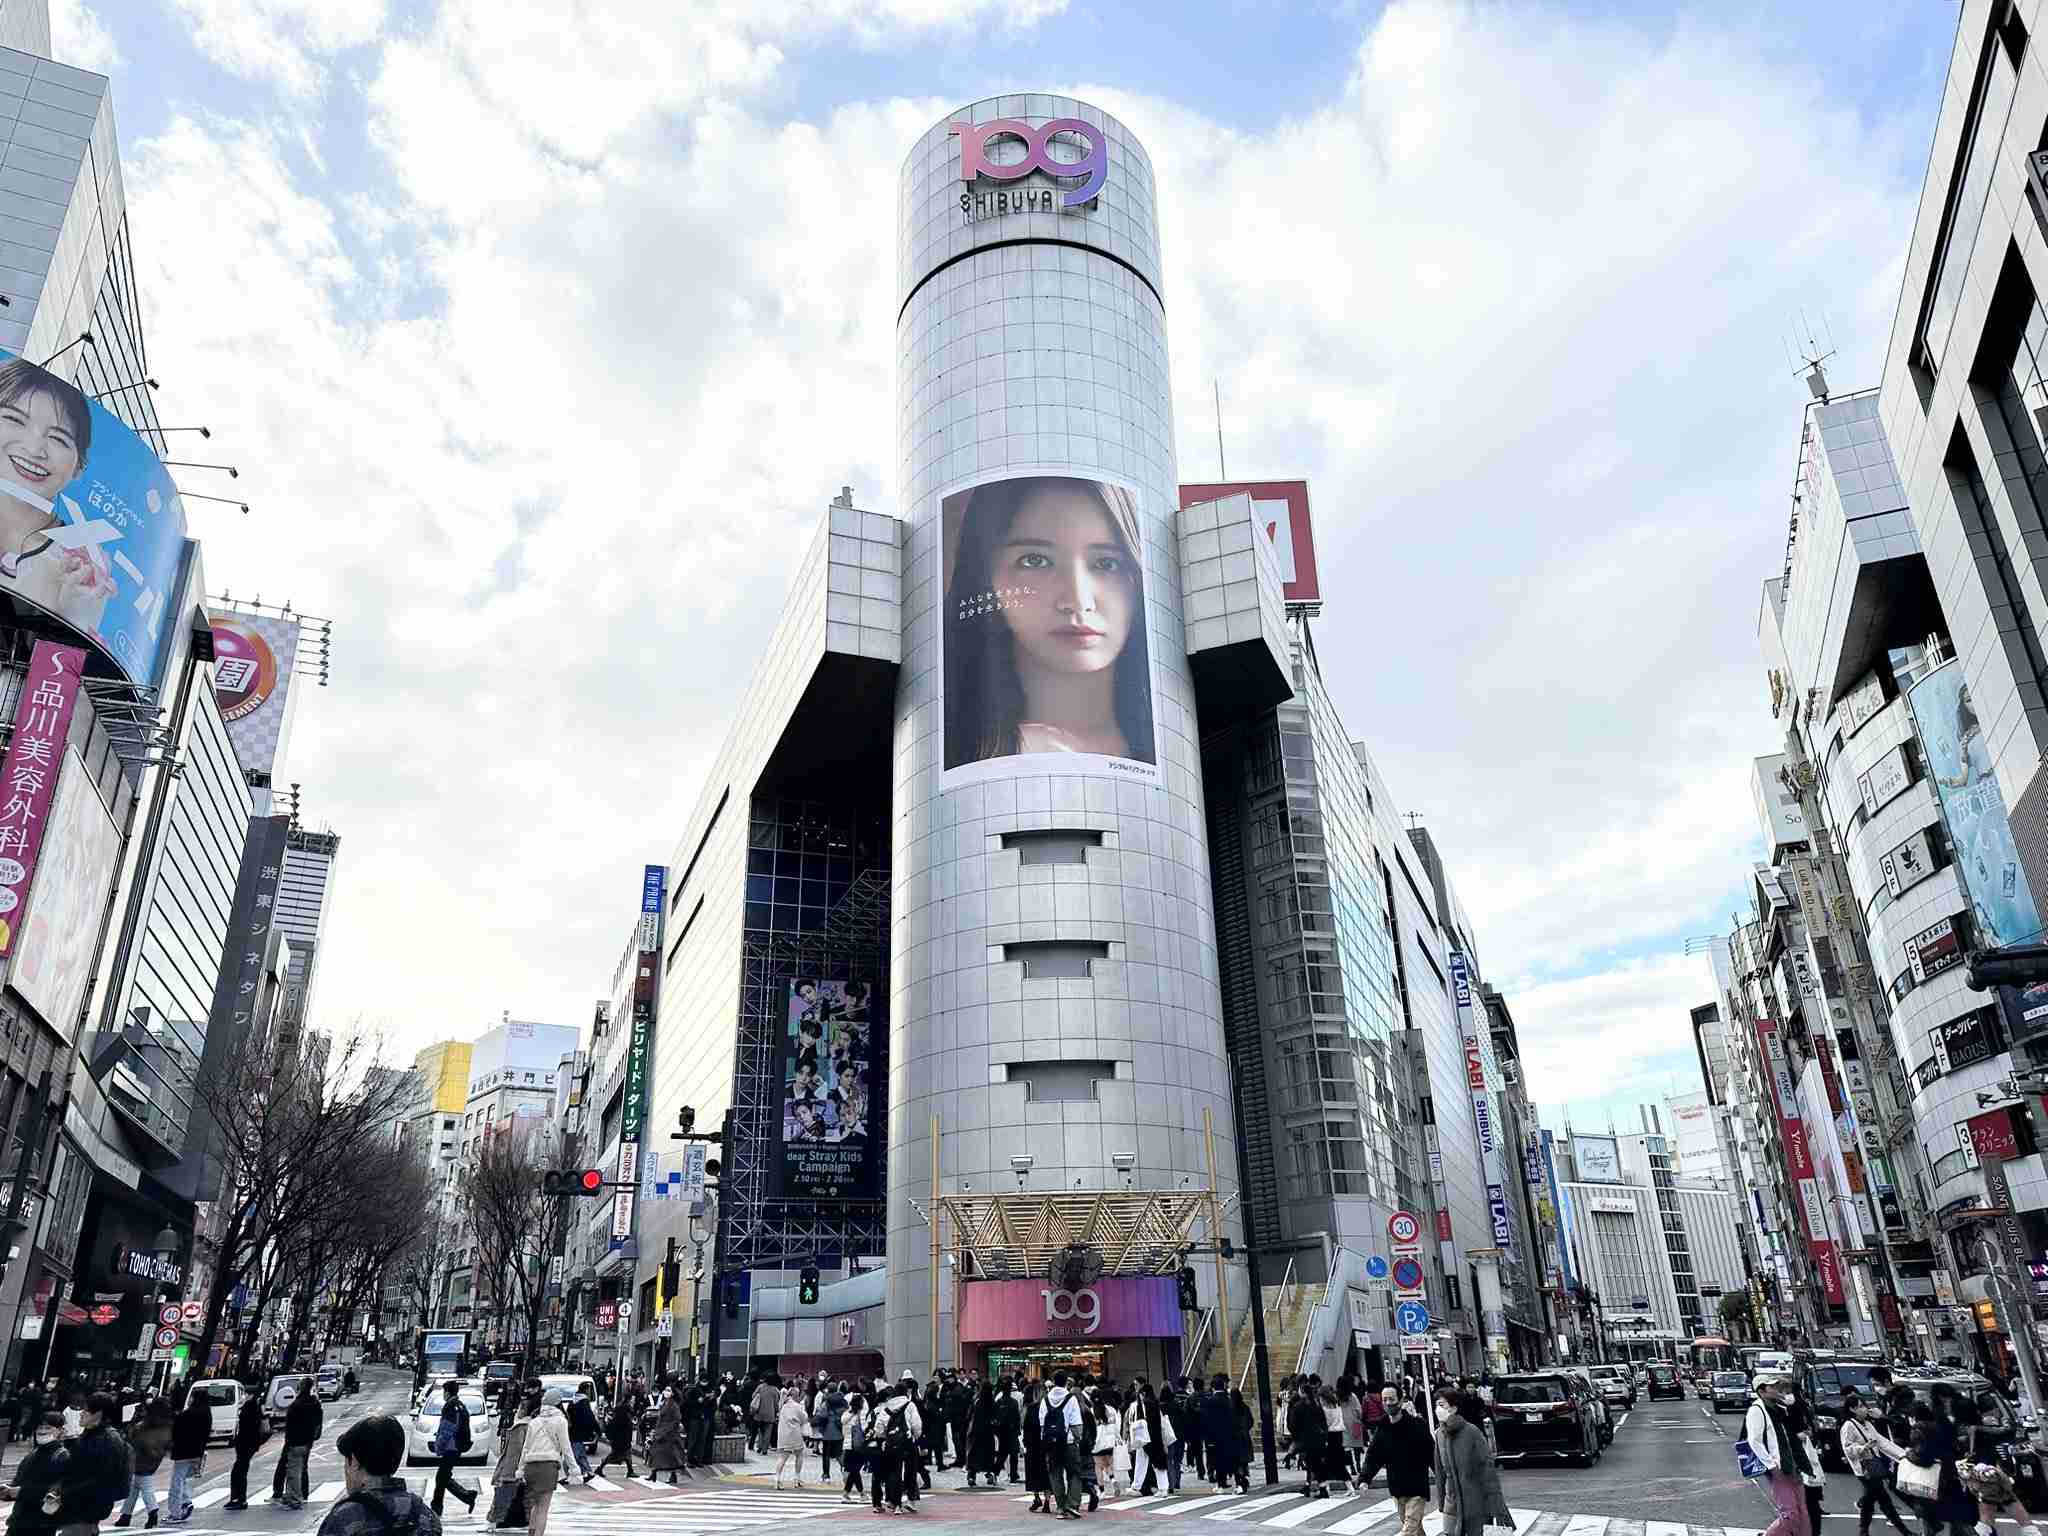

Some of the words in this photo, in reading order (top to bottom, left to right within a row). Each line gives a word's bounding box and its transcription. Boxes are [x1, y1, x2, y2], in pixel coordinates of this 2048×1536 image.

[949, 118, 1108, 207] 109
[960, 191, 1053, 212] SHIBUYA
[88, 489, 127, 527] ほのか
[0, 679, 65, 857] 品川美容外科
[1453, 968, 1472, 1008] LABI
[1945, 1018, 1978, 1040] ダーツバー
[626, 1021, 646, 1130] ビリヤード・ダーツ
[1467, 1048, 1486, 1089] LABI
[1476, 1100, 1493, 1153] SHIBUYA
[809, 1150, 837, 1162] Stray
[840, 1151, 863, 1162] Kids
[1979, 1134, 2015, 1153] クリニック
[799, 1161, 851, 1174] Campaign
[1991, 1176, 2010, 1209] SAINT
[1395, 1220, 1413, 1235] 30
[1492, 1203, 1509, 1246] LABI
[2003, 1214, 2021, 1245] OUIS
[129, 1252, 151, 1277] TOHO
[150, 1258, 182, 1285] CINEMAS
[599, 1315, 614, 1326] QLO
[600, 1306, 614, 1315] UNI
[1040, 1288, 1101, 1335] 109
[1405, 1311, 1416, 1330] P
